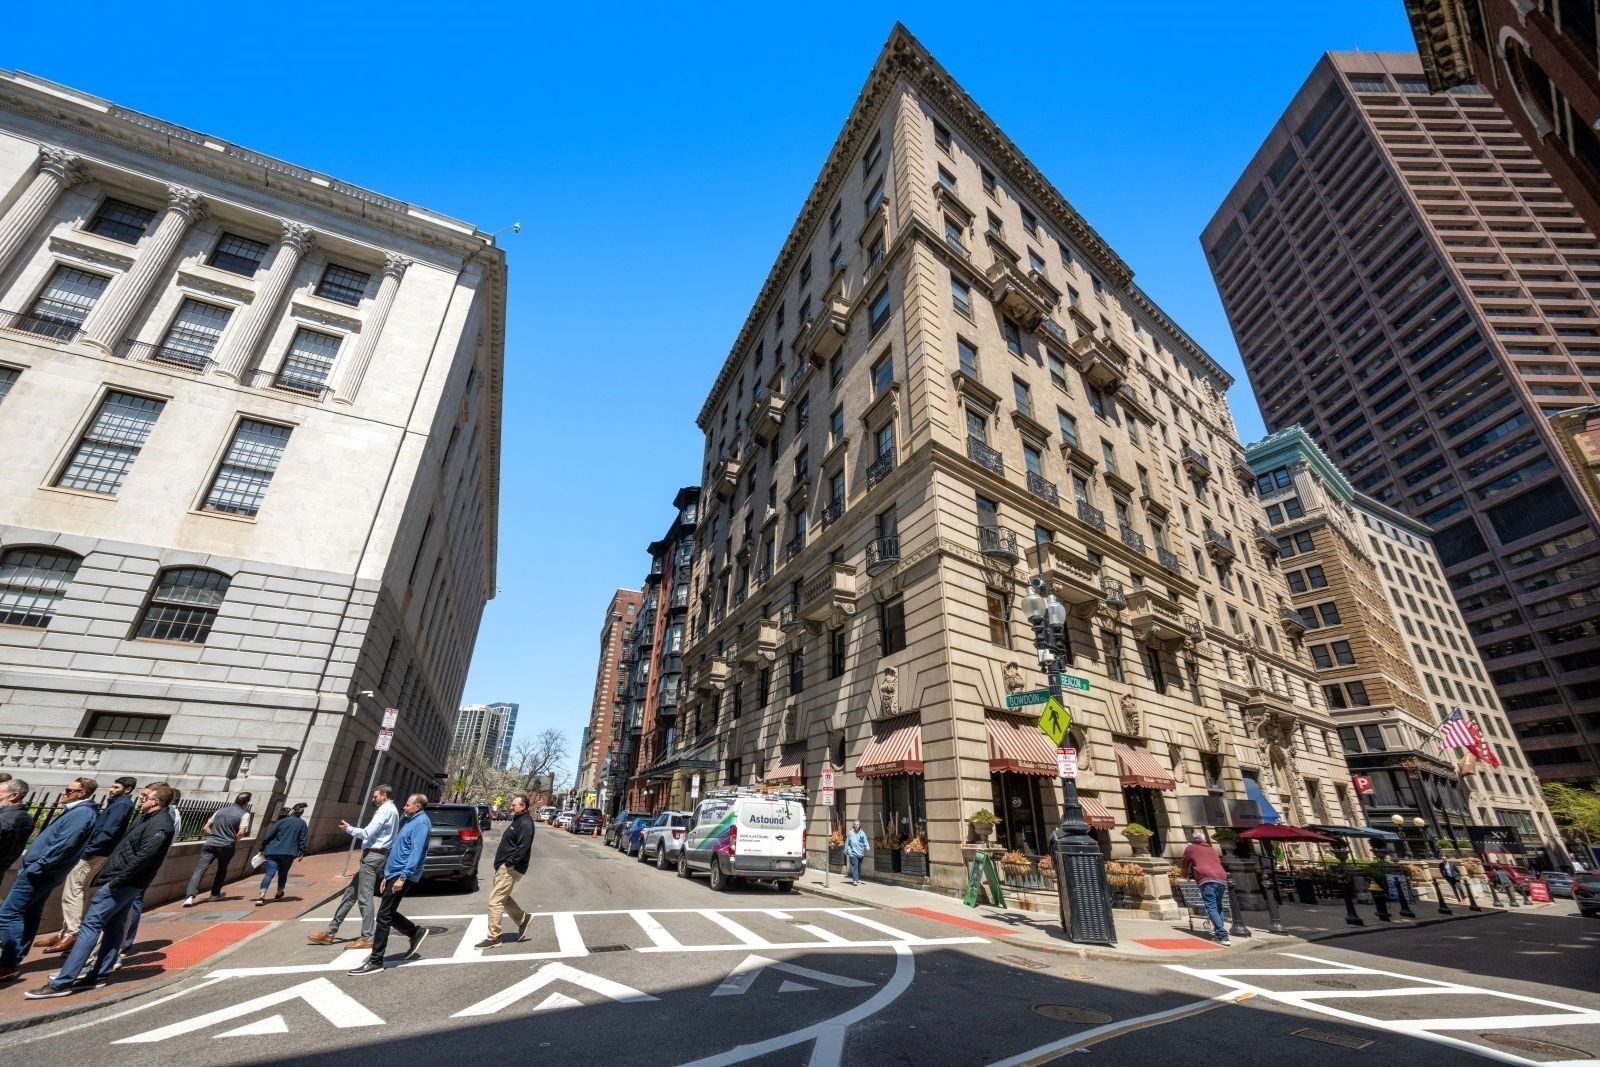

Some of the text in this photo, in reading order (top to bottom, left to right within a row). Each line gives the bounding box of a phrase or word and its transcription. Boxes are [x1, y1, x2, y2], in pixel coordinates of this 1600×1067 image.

[1061, 675, 1080, 689] BEACON
[1010, 694, 1039, 706] BOWDOIN
[1358, 778, 1368, 789] P
[750, 814, 784, 825] Astound
